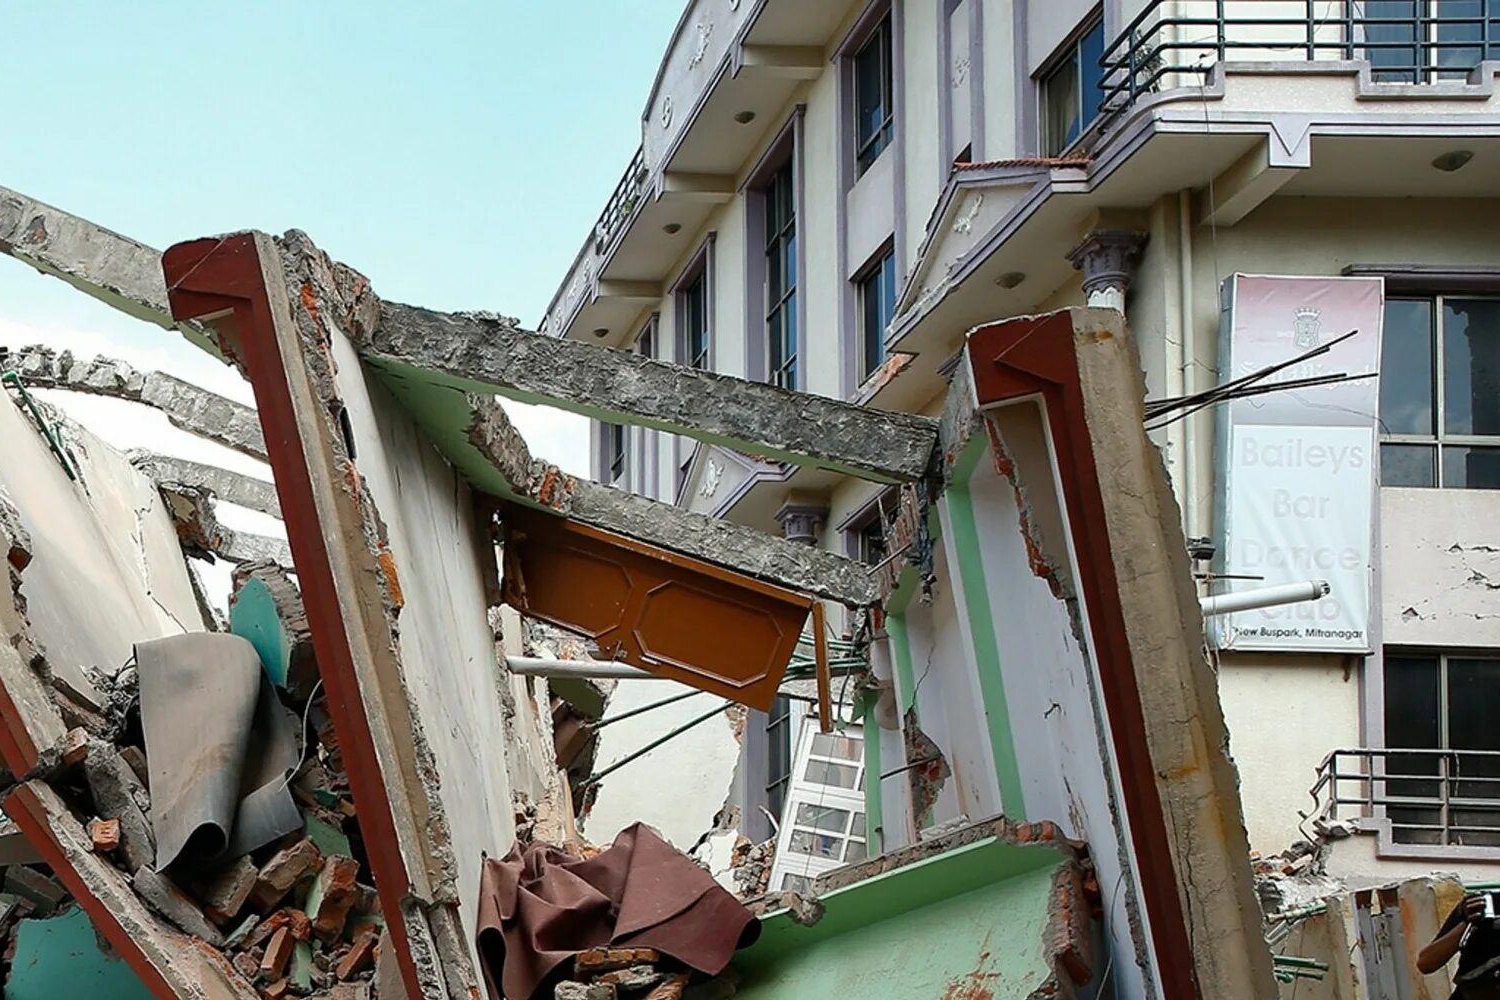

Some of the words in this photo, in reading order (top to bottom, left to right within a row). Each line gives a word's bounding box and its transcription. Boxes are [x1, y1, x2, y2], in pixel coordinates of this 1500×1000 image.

[1241, 437, 1365, 475] Baileys
[1273, 488, 1331, 519] Bar
[1241, 539, 1362, 570] Dance
[1260, 627, 1302, 639] Buspark,
[1304, 628, 1364, 641] Mitranagar
